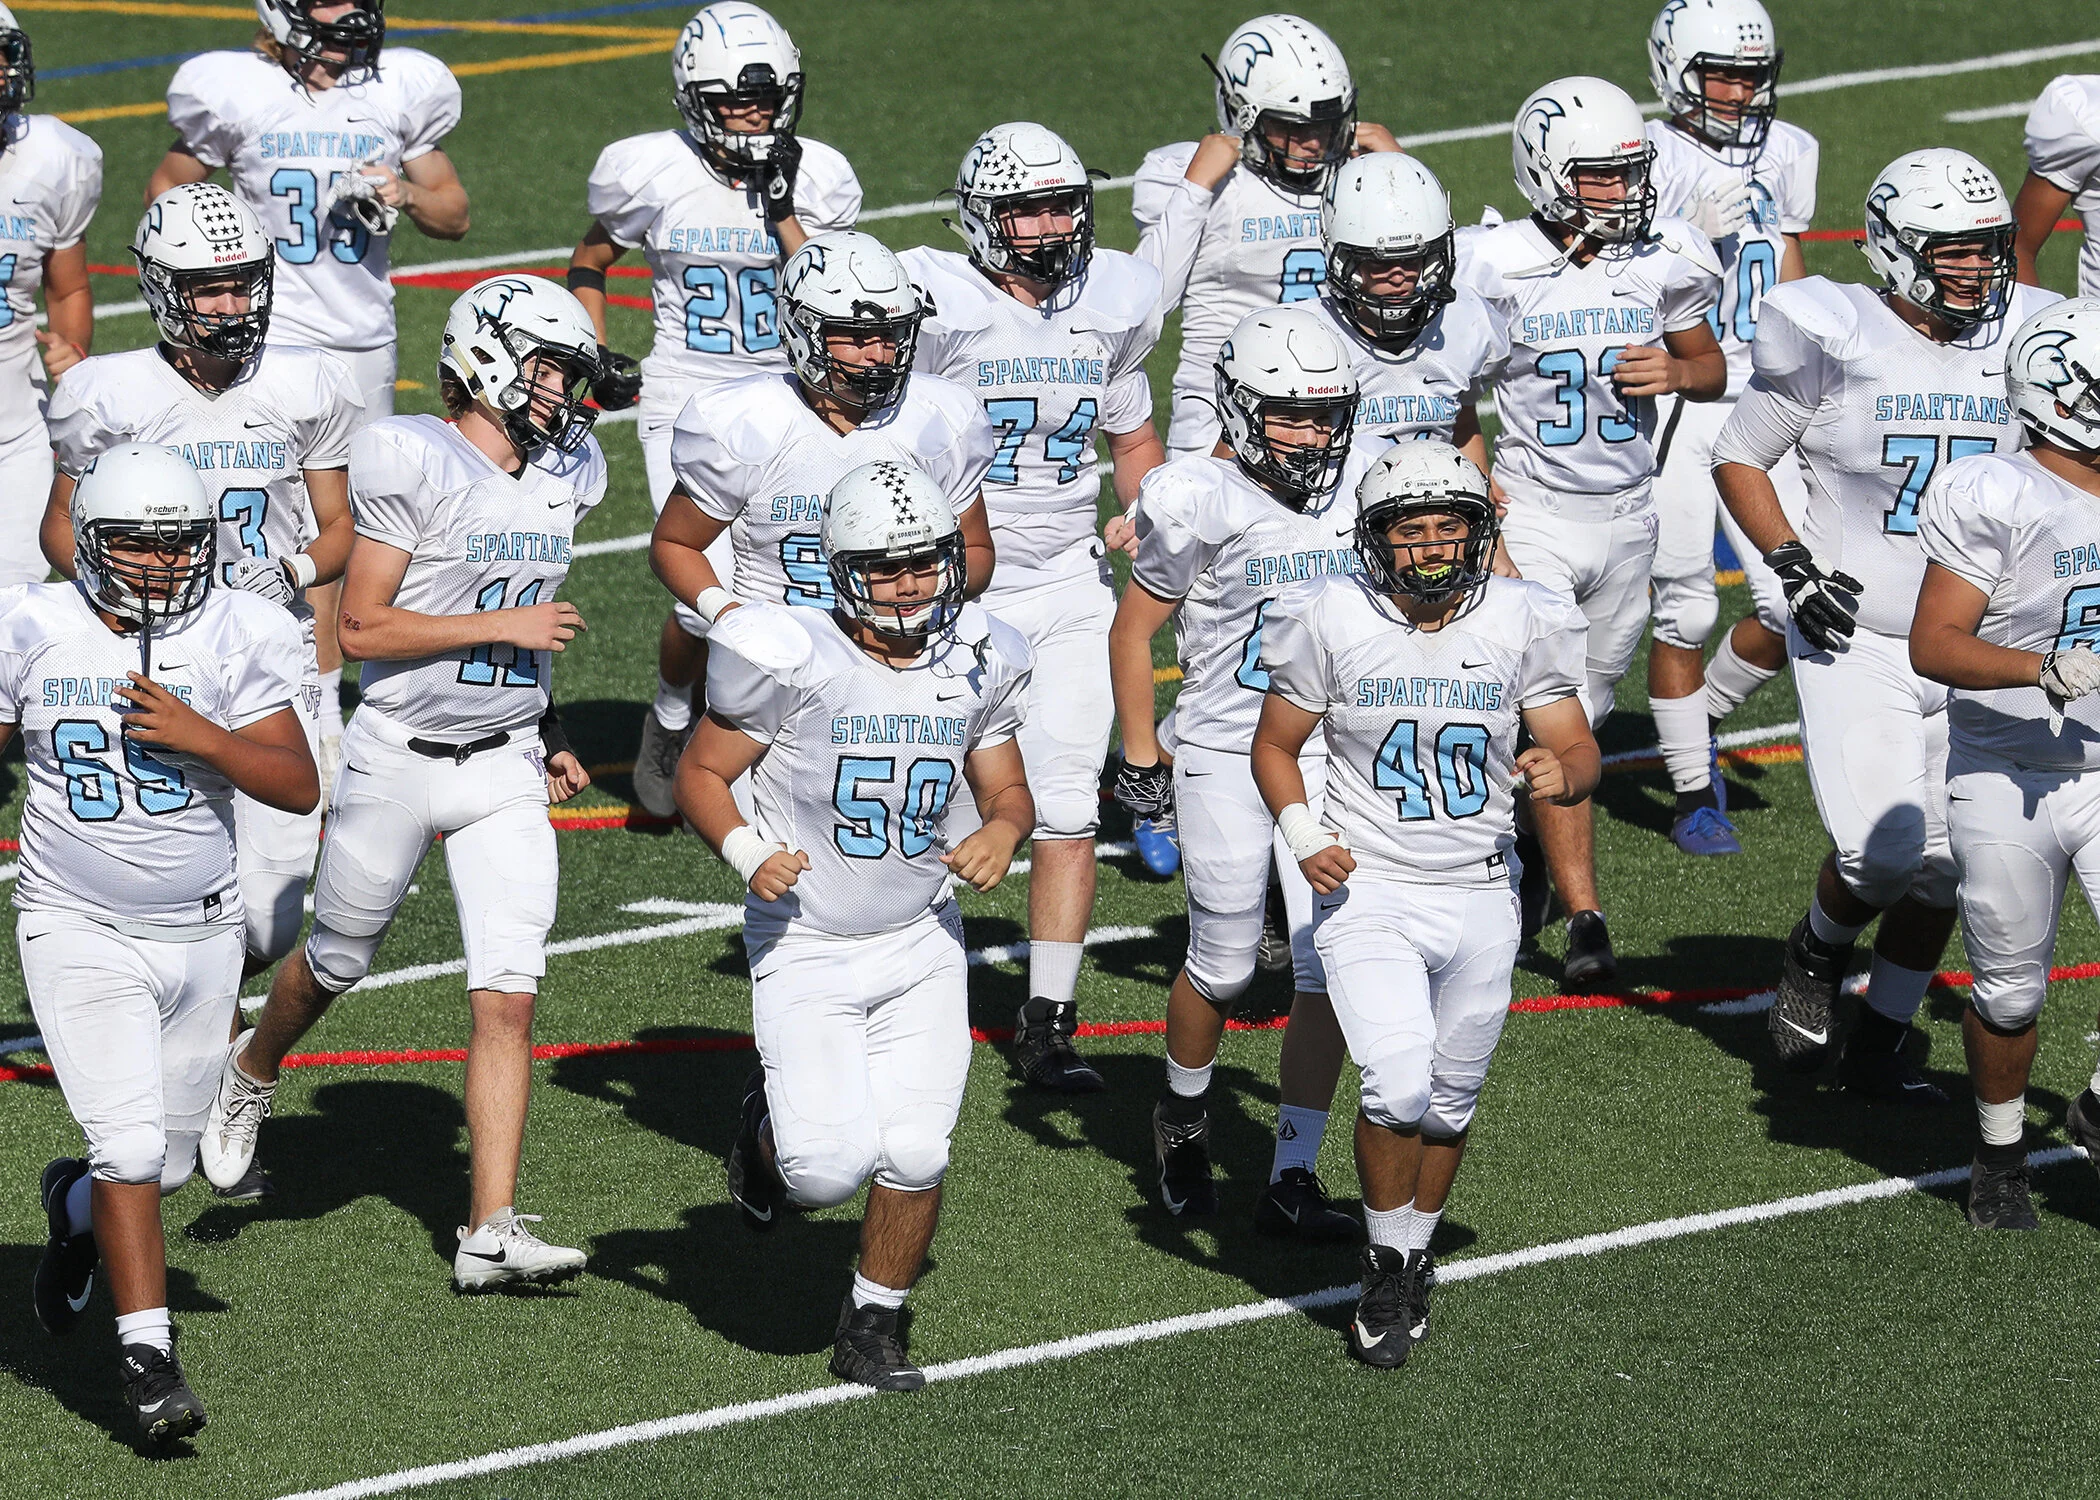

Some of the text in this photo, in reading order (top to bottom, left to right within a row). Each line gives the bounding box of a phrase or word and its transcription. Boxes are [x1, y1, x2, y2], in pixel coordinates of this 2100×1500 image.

[669, 227, 780, 255] SPARTAN
[1241, 213, 1320, 243] SPART
[214, 251, 248, 264] Riddell
[683, 264, 780, 354] 26
[1523, 308, 1654, 342] SPARTANS
[978, 357, 1103, 386] SPARTANS
[1307, 385, 1339, 395] Riddell
[1353, 396, 1457, 426] PARTANS
[1875, 393, 2009, 425] SPARTANS
[182, 440, 286, 470] ARTANS
[984, 397, 1098, 486] 74
[153, 505, 179, 515] schutt
[466, 532, 573, 564] SPARTANS
[897, 530, 922, 539] SPARTAN
[456, 577, 545, 688] 11
[1357, 677, 1503, 711] SPARTANS
[832, 714, 967, 746] SPARTANS
[1372, 719, 1492, 822] 40
[832, 755, 956, 860] 50
